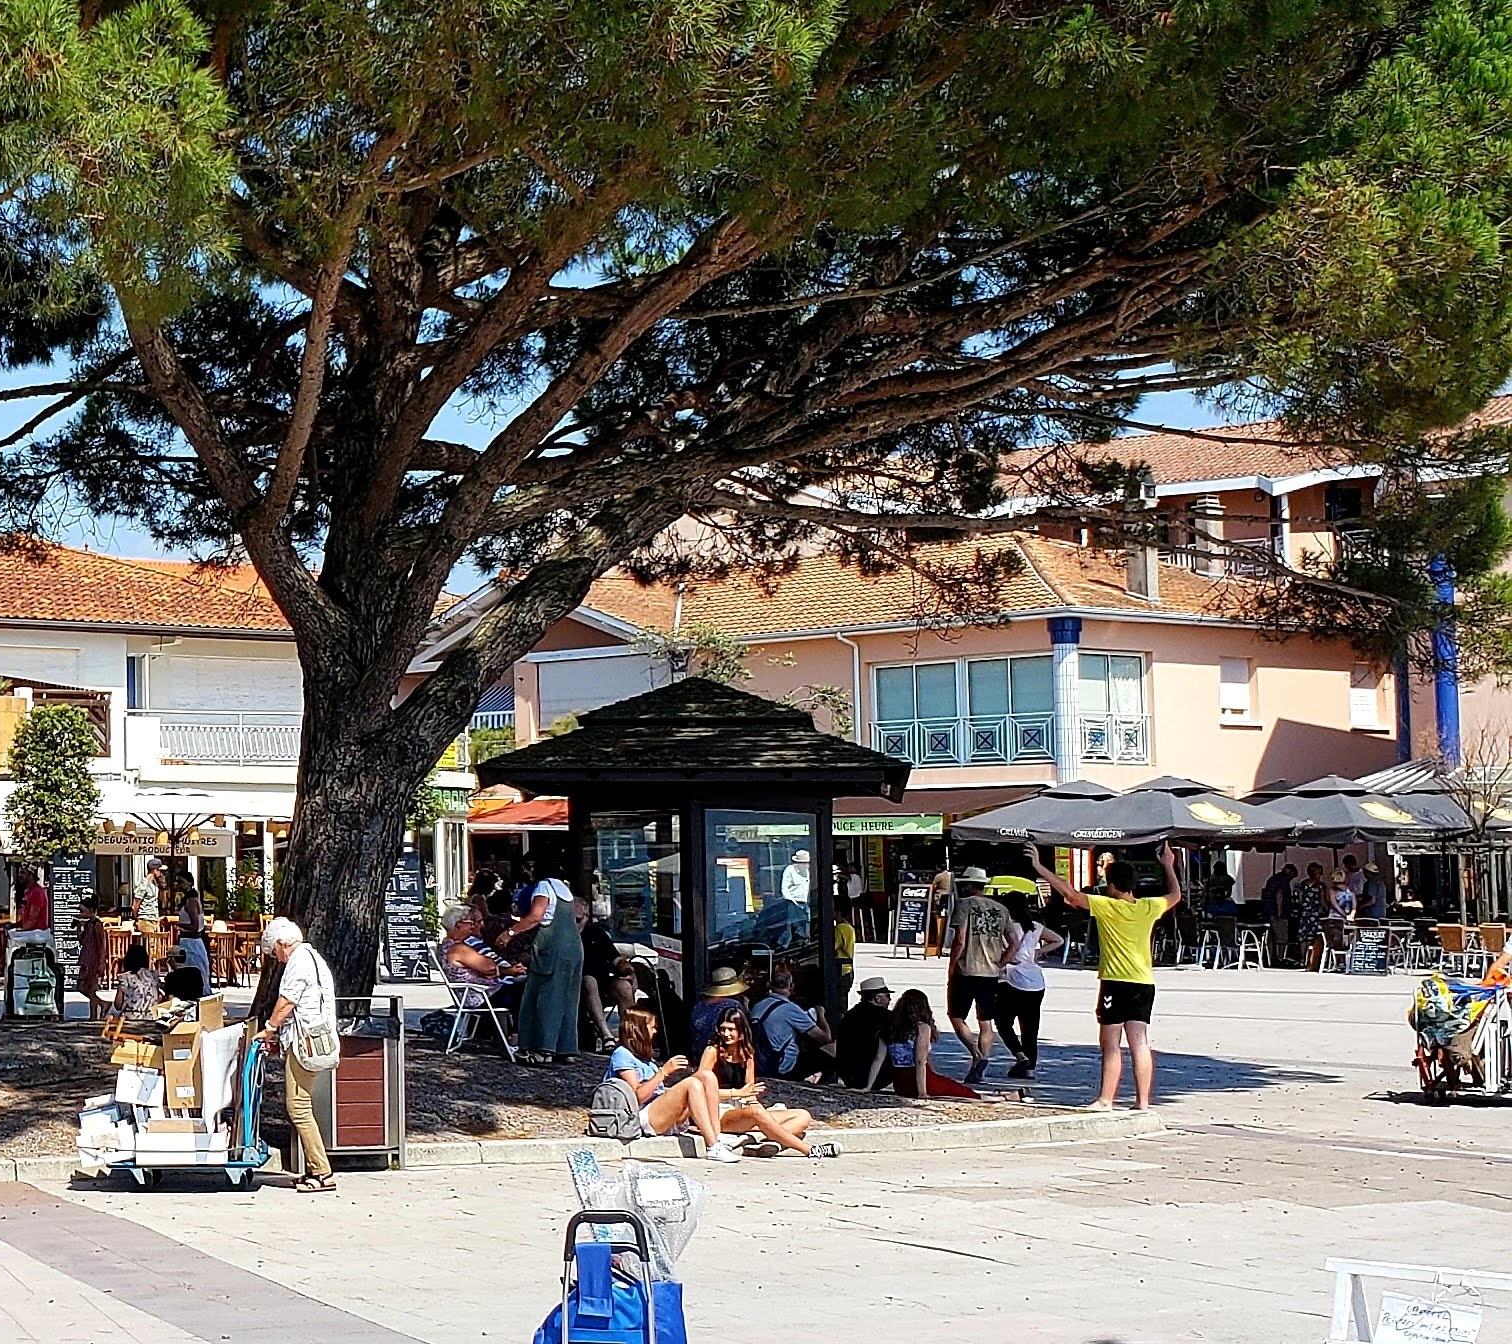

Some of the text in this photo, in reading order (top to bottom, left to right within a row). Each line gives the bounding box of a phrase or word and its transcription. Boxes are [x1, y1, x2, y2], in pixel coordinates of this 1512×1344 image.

[860, 821, 894, 831] HEURE
[97, 835, 156, 845] DEGUSTATIO
[125, 845, 191, 854] du PRODUCEUR
